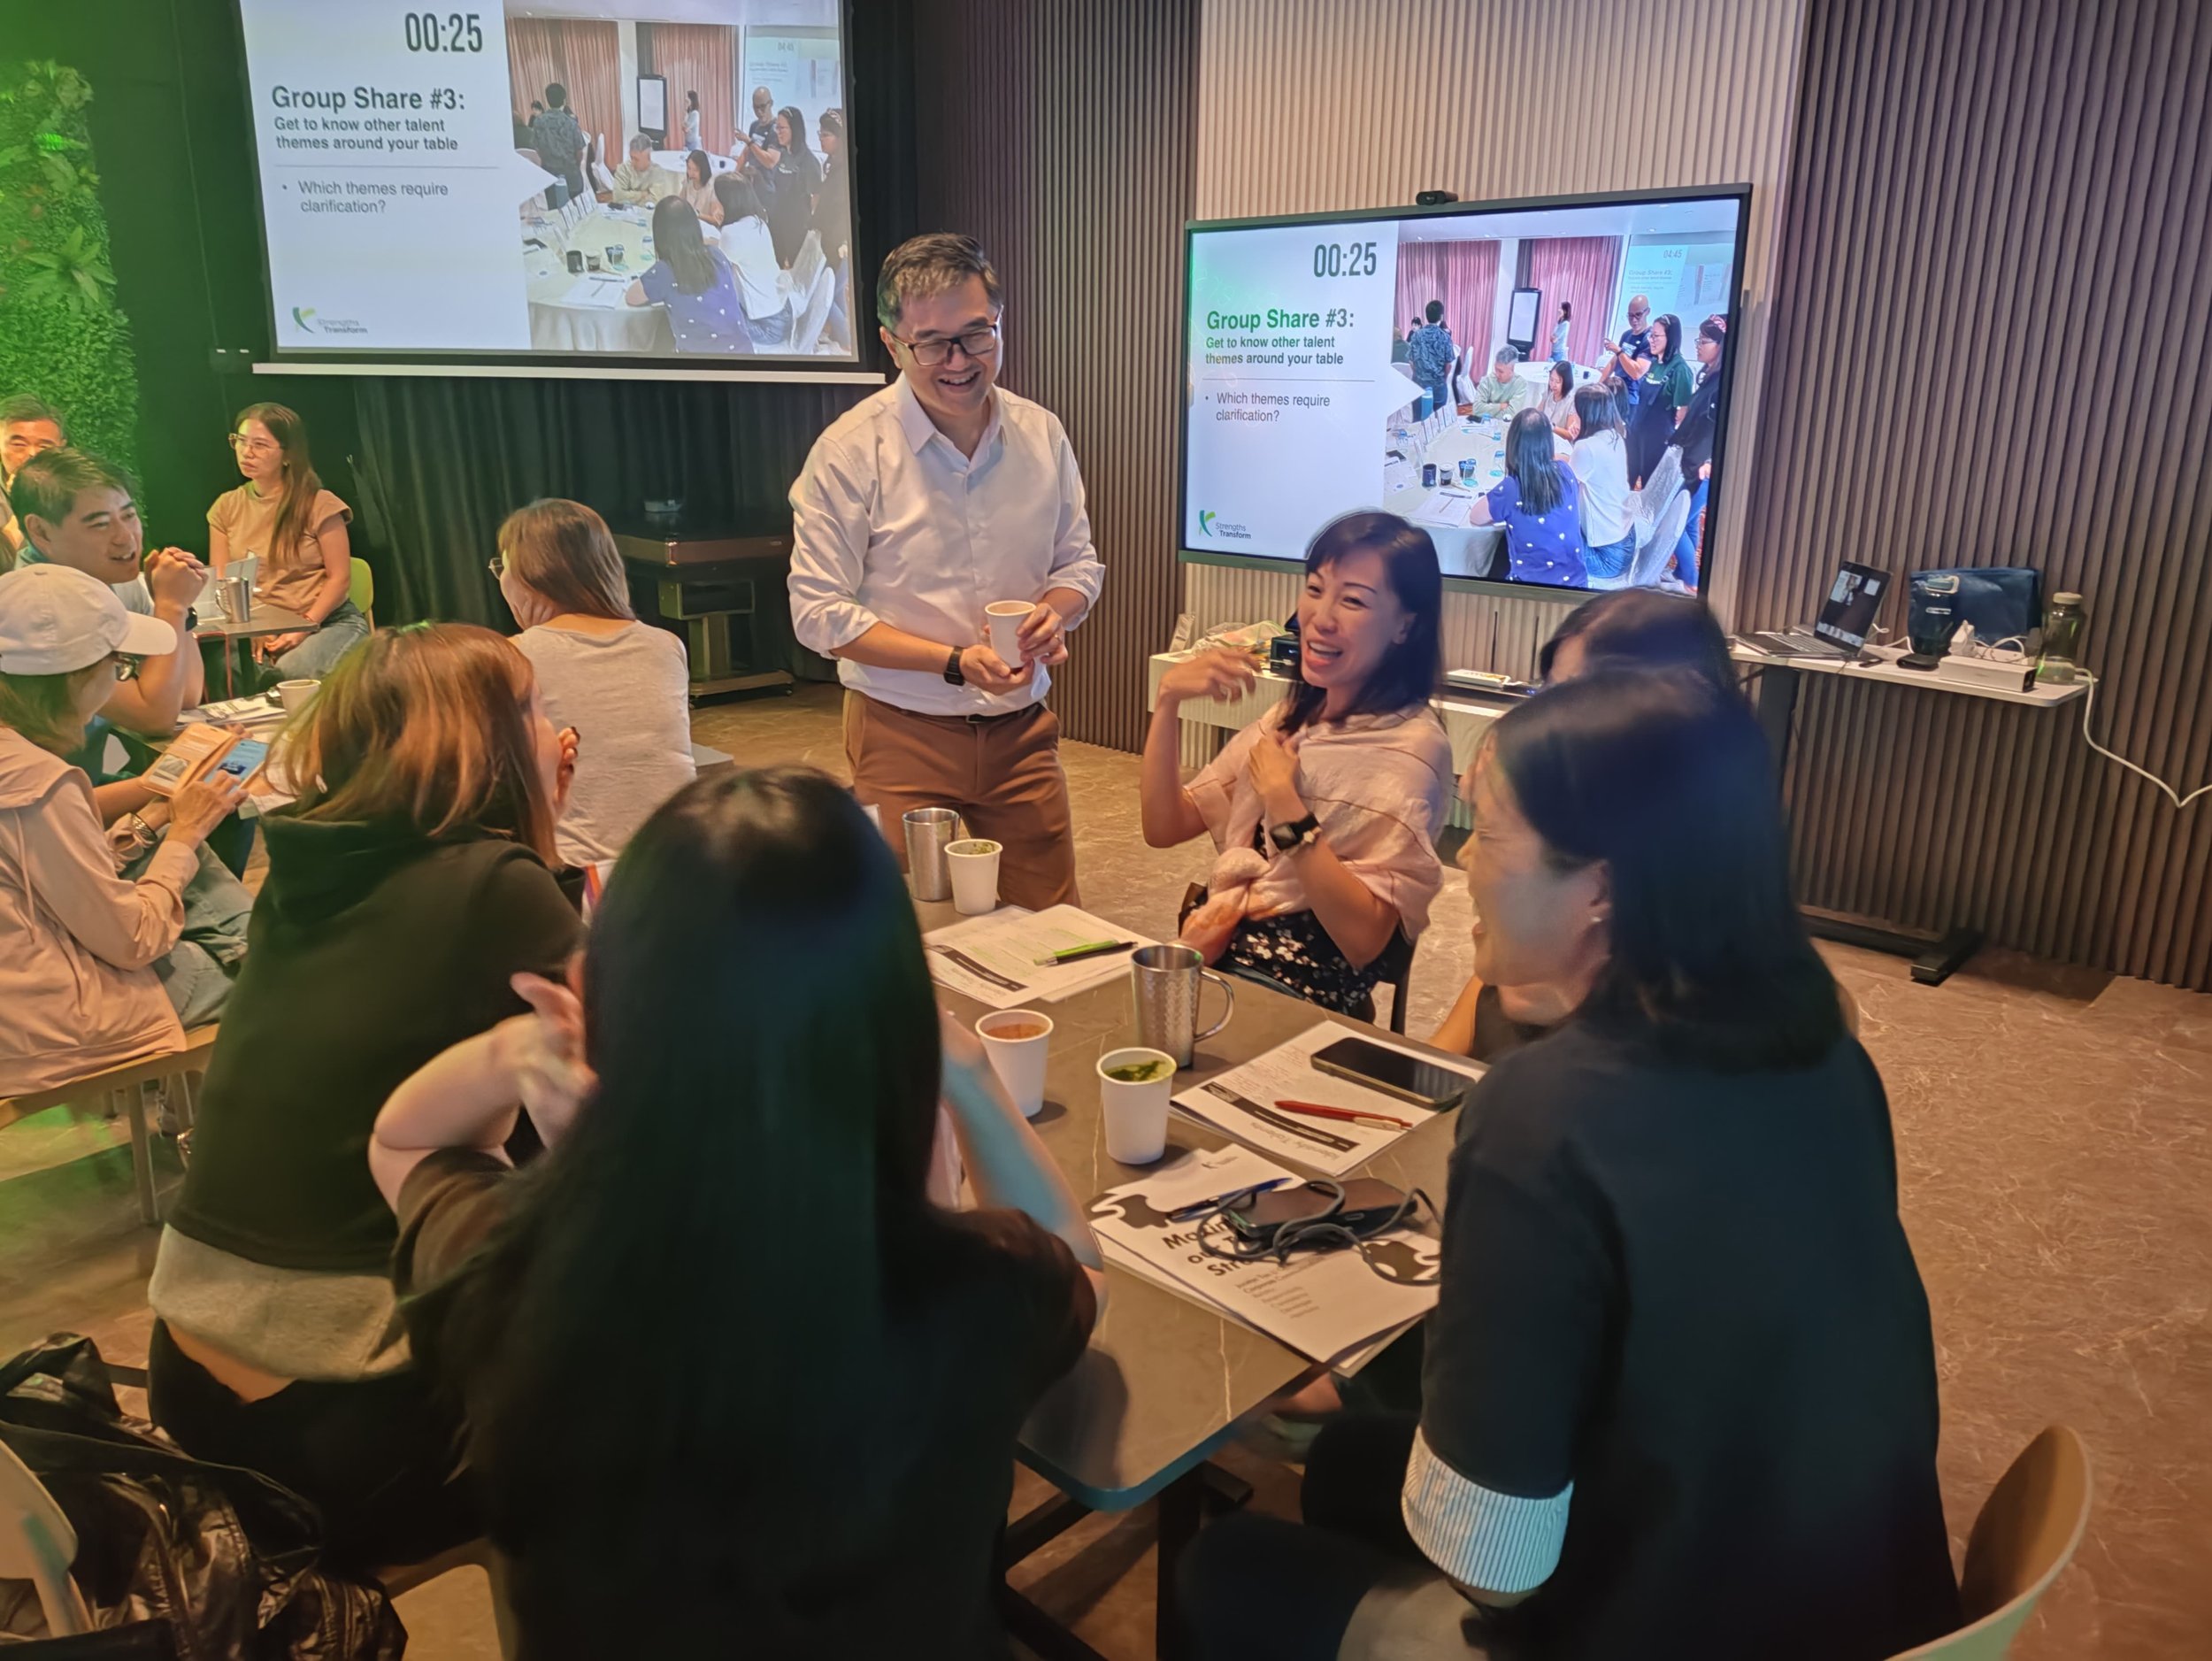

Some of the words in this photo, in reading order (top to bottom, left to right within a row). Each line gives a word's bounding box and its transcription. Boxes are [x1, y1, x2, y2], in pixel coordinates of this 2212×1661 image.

[405, 12, 482, 52] 00:25
[273, 86, 346, 114] Group
[354, 87, 422, 109] Share
[430, 88, 465, 110] #3:
[274, 117, 299, 130] Get
[303, 118, 318, 130] to
[322, 117, 359, 130] know
[365, 119, 401, 131] other
[405, 119, 444, 131] talent
[276, 135, 328, 149] themes
[334, 136, 383, 149] around
[388, 139, 419, 152] your
[424, 137, 457, 150] table
[298, 181, 342, 194] Which
[346, 181, 396, 195] themes
[401, 182, 448, 198] require
[301, 199, 386, 212] clarification?
[1314, 242, 1377, 277] 00:25
[1207, 311, 1260, 333] Group
[1267, 309, 1319, 328] Share
[1325, 309, 1354, 327] #3:
[1206, 337, 1224, 348] Get
[1227, 338, 1237, 348] to
[1240, 336, 1268, 347] know
[1271, 336, 1300, 347] other
[1303, 336, 1334, 347] talent
[1206, 353, 1243, 364] themes
[1247, 352, 1284, 364] around
[1287, 355, 1312, 366] your
[1316, 353, 1343, 364] table
[1217, 392, 1248, 404] Which
[1251, 393, 1289, 405] themes
[1293, 395, 1330, 409] require
[1216, 409, 1279, 421] clarification?
[1215, 522, 1247, 531] Strengths
[1219, 529, 1252, 539] Transform
